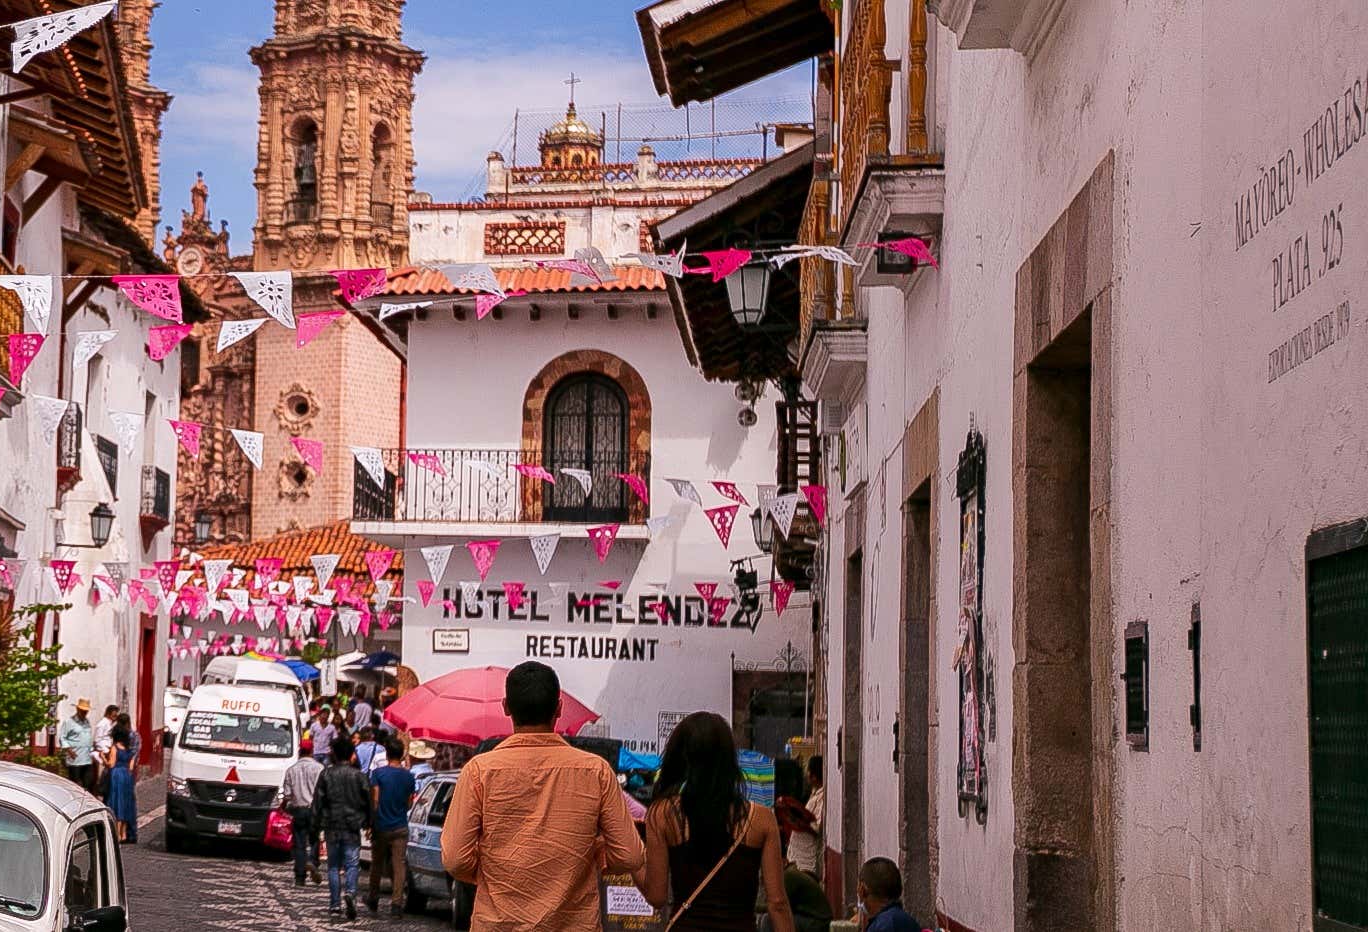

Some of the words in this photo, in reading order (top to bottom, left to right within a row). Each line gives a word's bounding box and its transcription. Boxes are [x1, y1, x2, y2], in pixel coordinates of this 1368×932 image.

[1272, 230, 1311, 313] PLATA
[1318, 202, 1344, 279] 925
[526, 634, 659, 661] RESTAURANT
[222, 699, 261, 713] RUFFO
